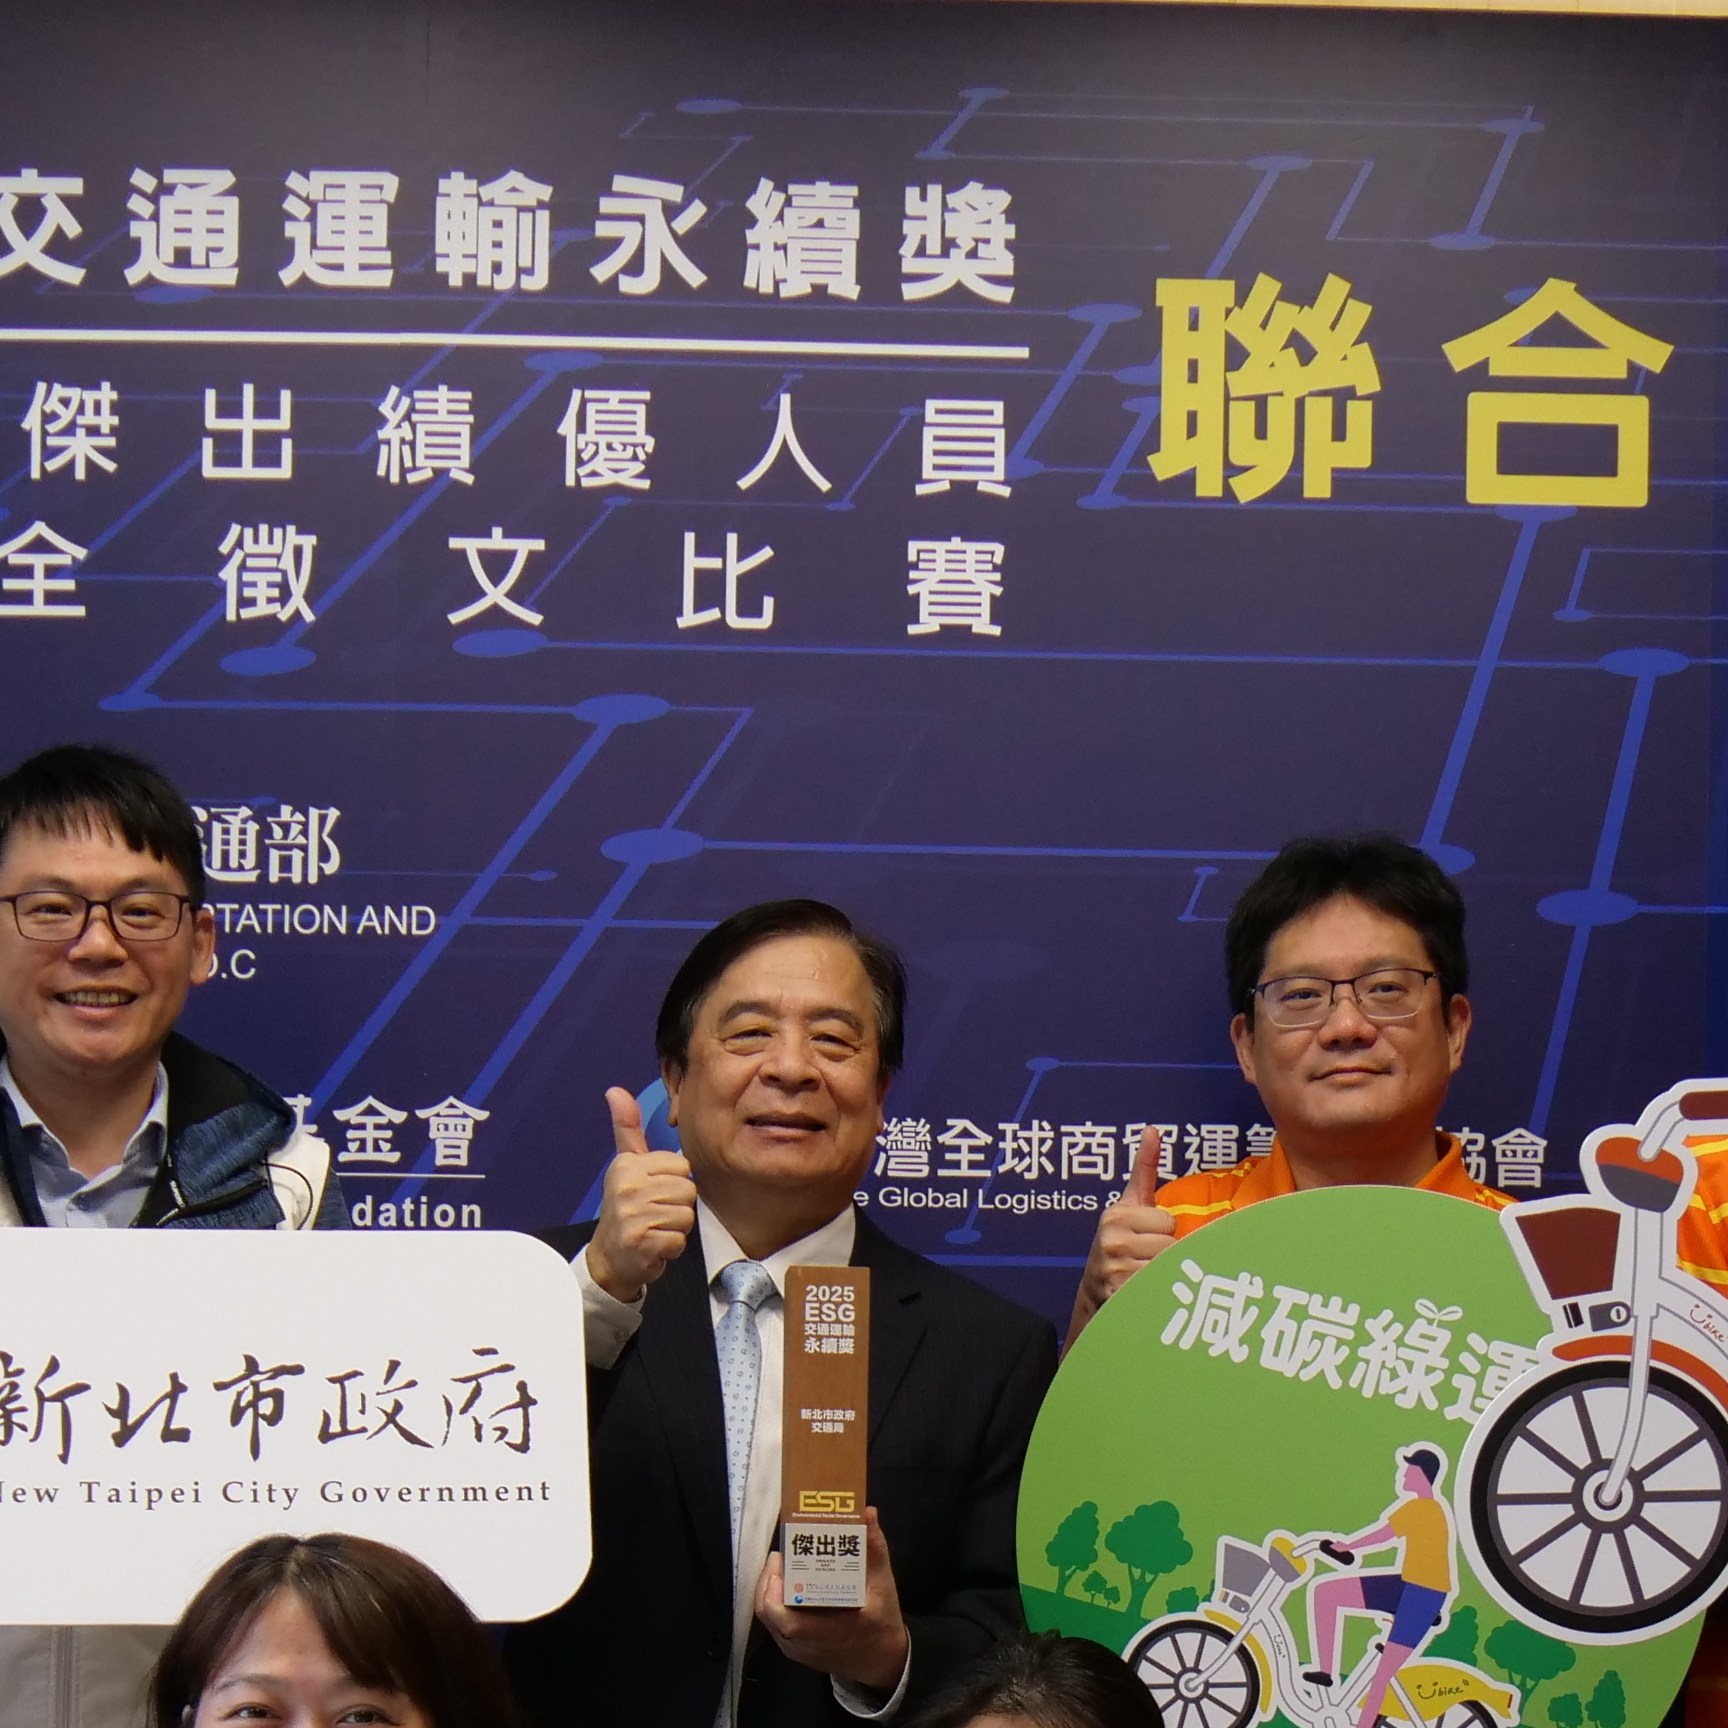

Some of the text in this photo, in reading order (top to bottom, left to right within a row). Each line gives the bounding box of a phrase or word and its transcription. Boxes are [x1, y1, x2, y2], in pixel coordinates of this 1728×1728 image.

[357, 905, 436, 935] AND
[879, 1187, 968, 1209] Global
[978, 1189, 1098, 1214] Logistics
[805, 1285, 855, 1302] 2025
[805, 1303, 855, 1321] ESG
[804, 1323, 855, 1336] 交通運輸
[804, 1338, 855, 1354] 永續獎
[800, 1408, 855, 1421] 新北市政府
[811, 1422, 844, 1434] 交通局
[80, 1480, 203, 1511] Taipei
[222, 1480, 300, 1511] City
[319, 1480, 553, 1504] Government
[799, 1491, 855, 1512] ESG
[792, 1533, 860, 1557] 傑出獎
